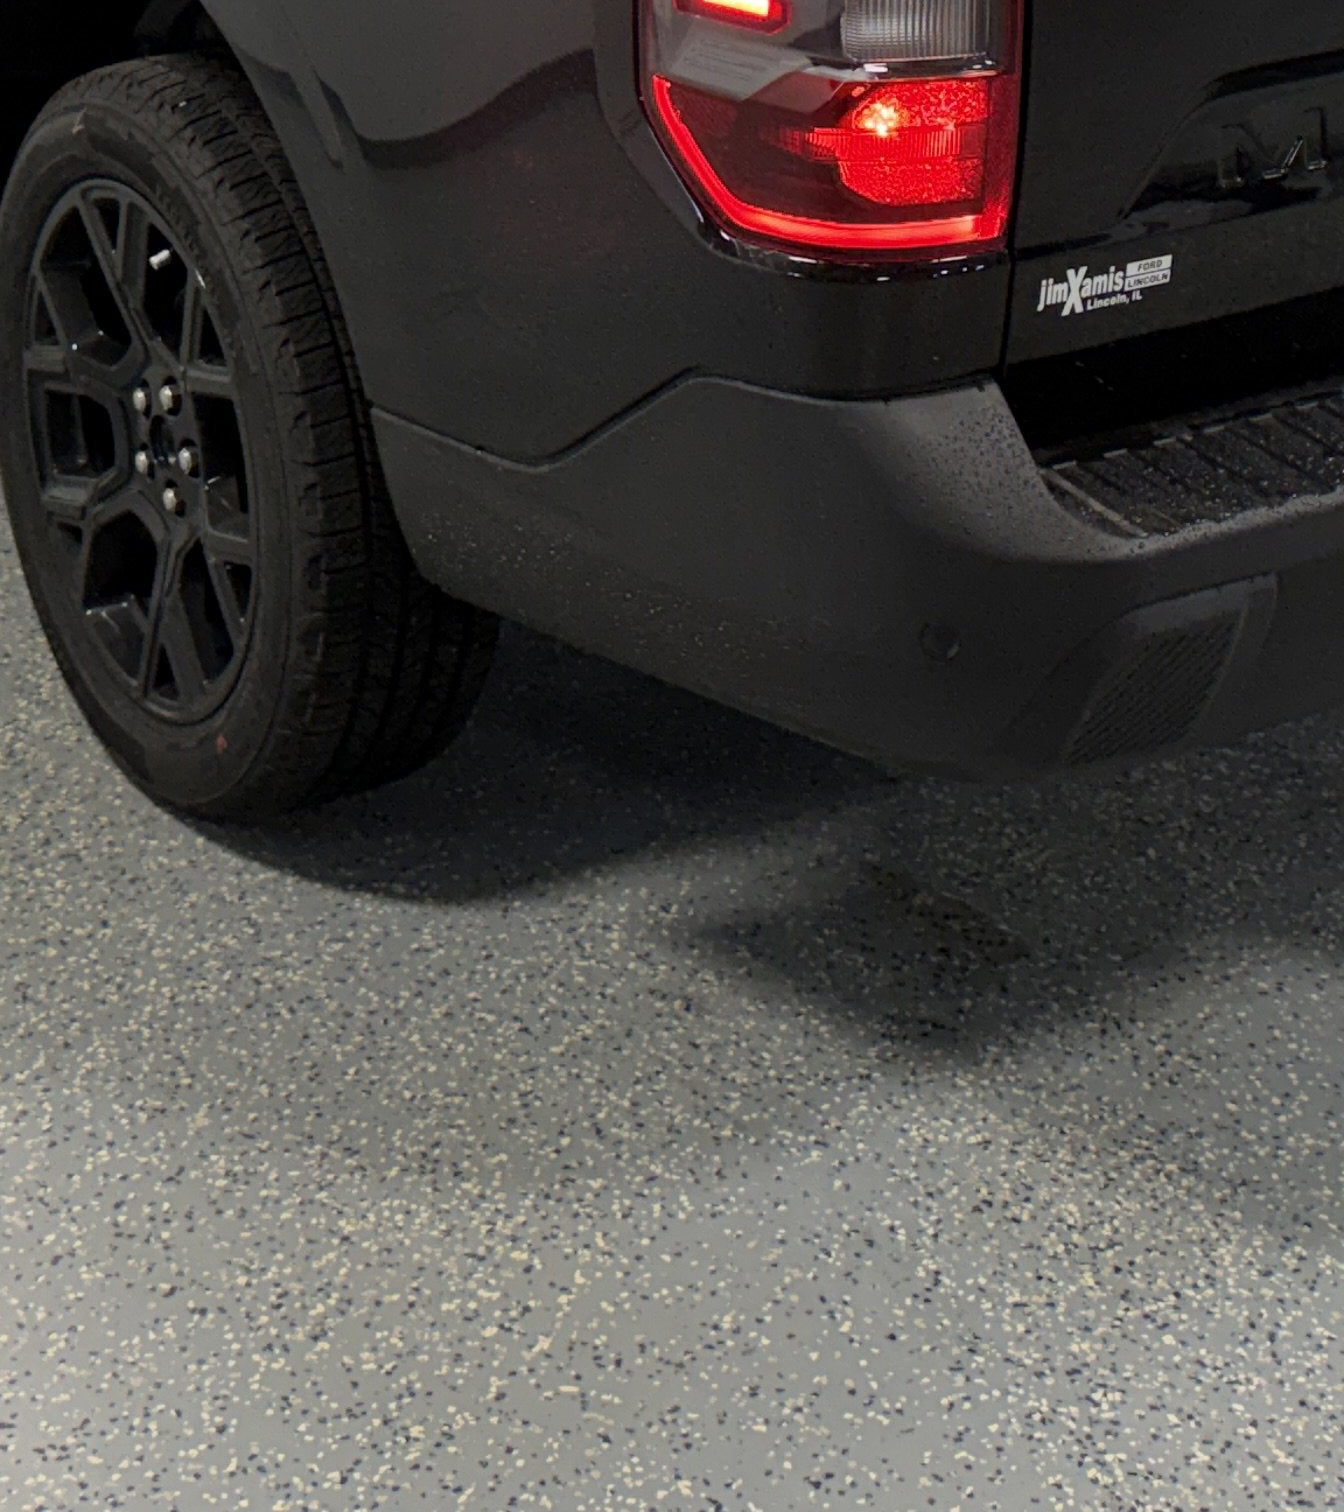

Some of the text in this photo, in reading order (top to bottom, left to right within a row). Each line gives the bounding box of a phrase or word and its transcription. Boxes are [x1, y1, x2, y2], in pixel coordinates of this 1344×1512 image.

[1138, 260, 1162, 271] FORD
[1127, 272, 1169, 288] LINCOLN
[1132, 290, 1142, 300] IL
